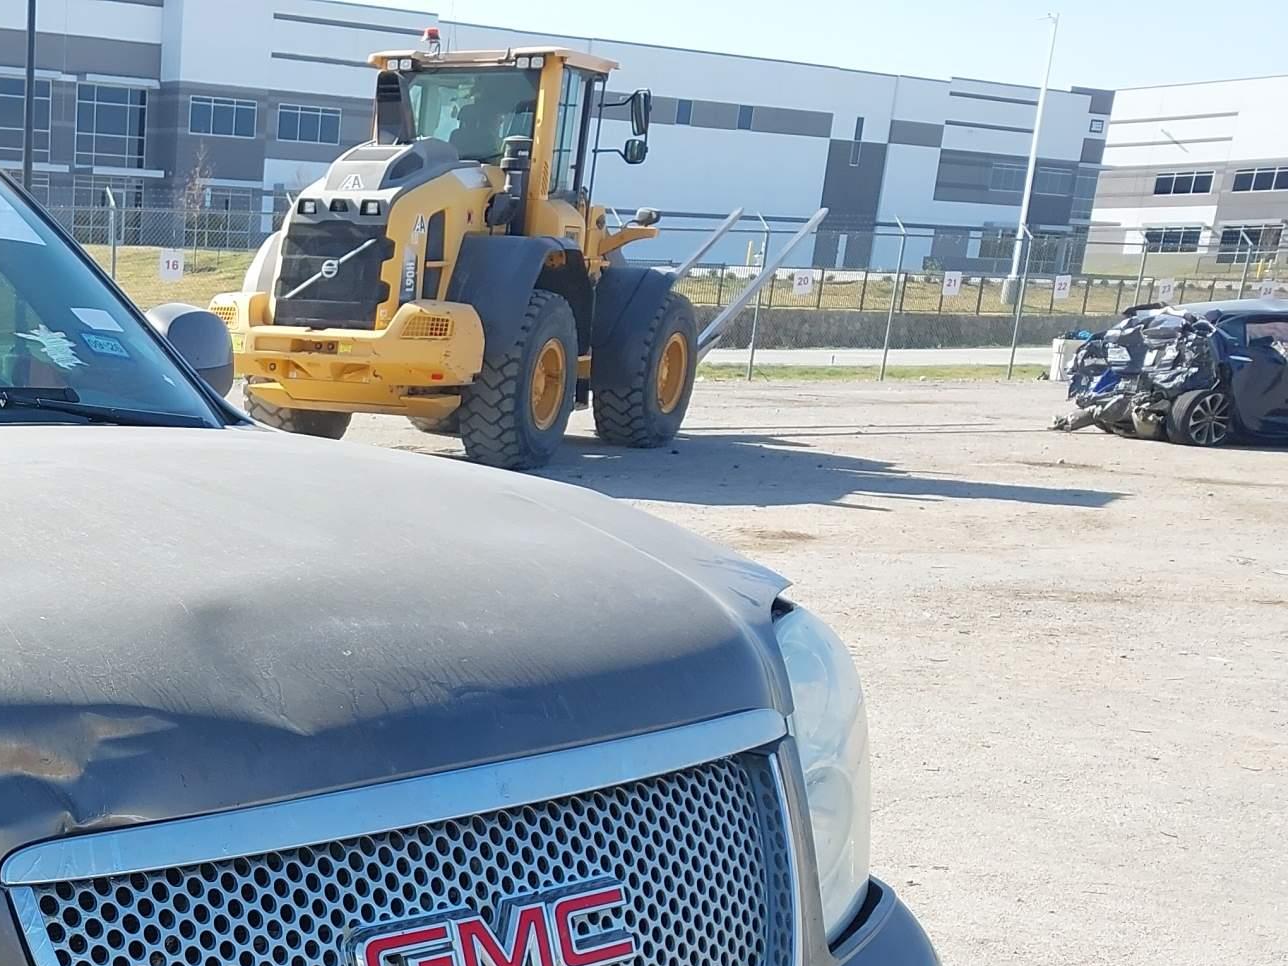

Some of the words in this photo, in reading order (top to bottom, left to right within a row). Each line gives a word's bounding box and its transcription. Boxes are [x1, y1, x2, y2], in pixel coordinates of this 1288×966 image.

[165, 259, 179, 271] 16
[405, 262, 415, 292] L90H
[797, 276, 809, 286] 20
[946, 278, 957, 287] 21
[1057, 282, 1068, 291] 22
